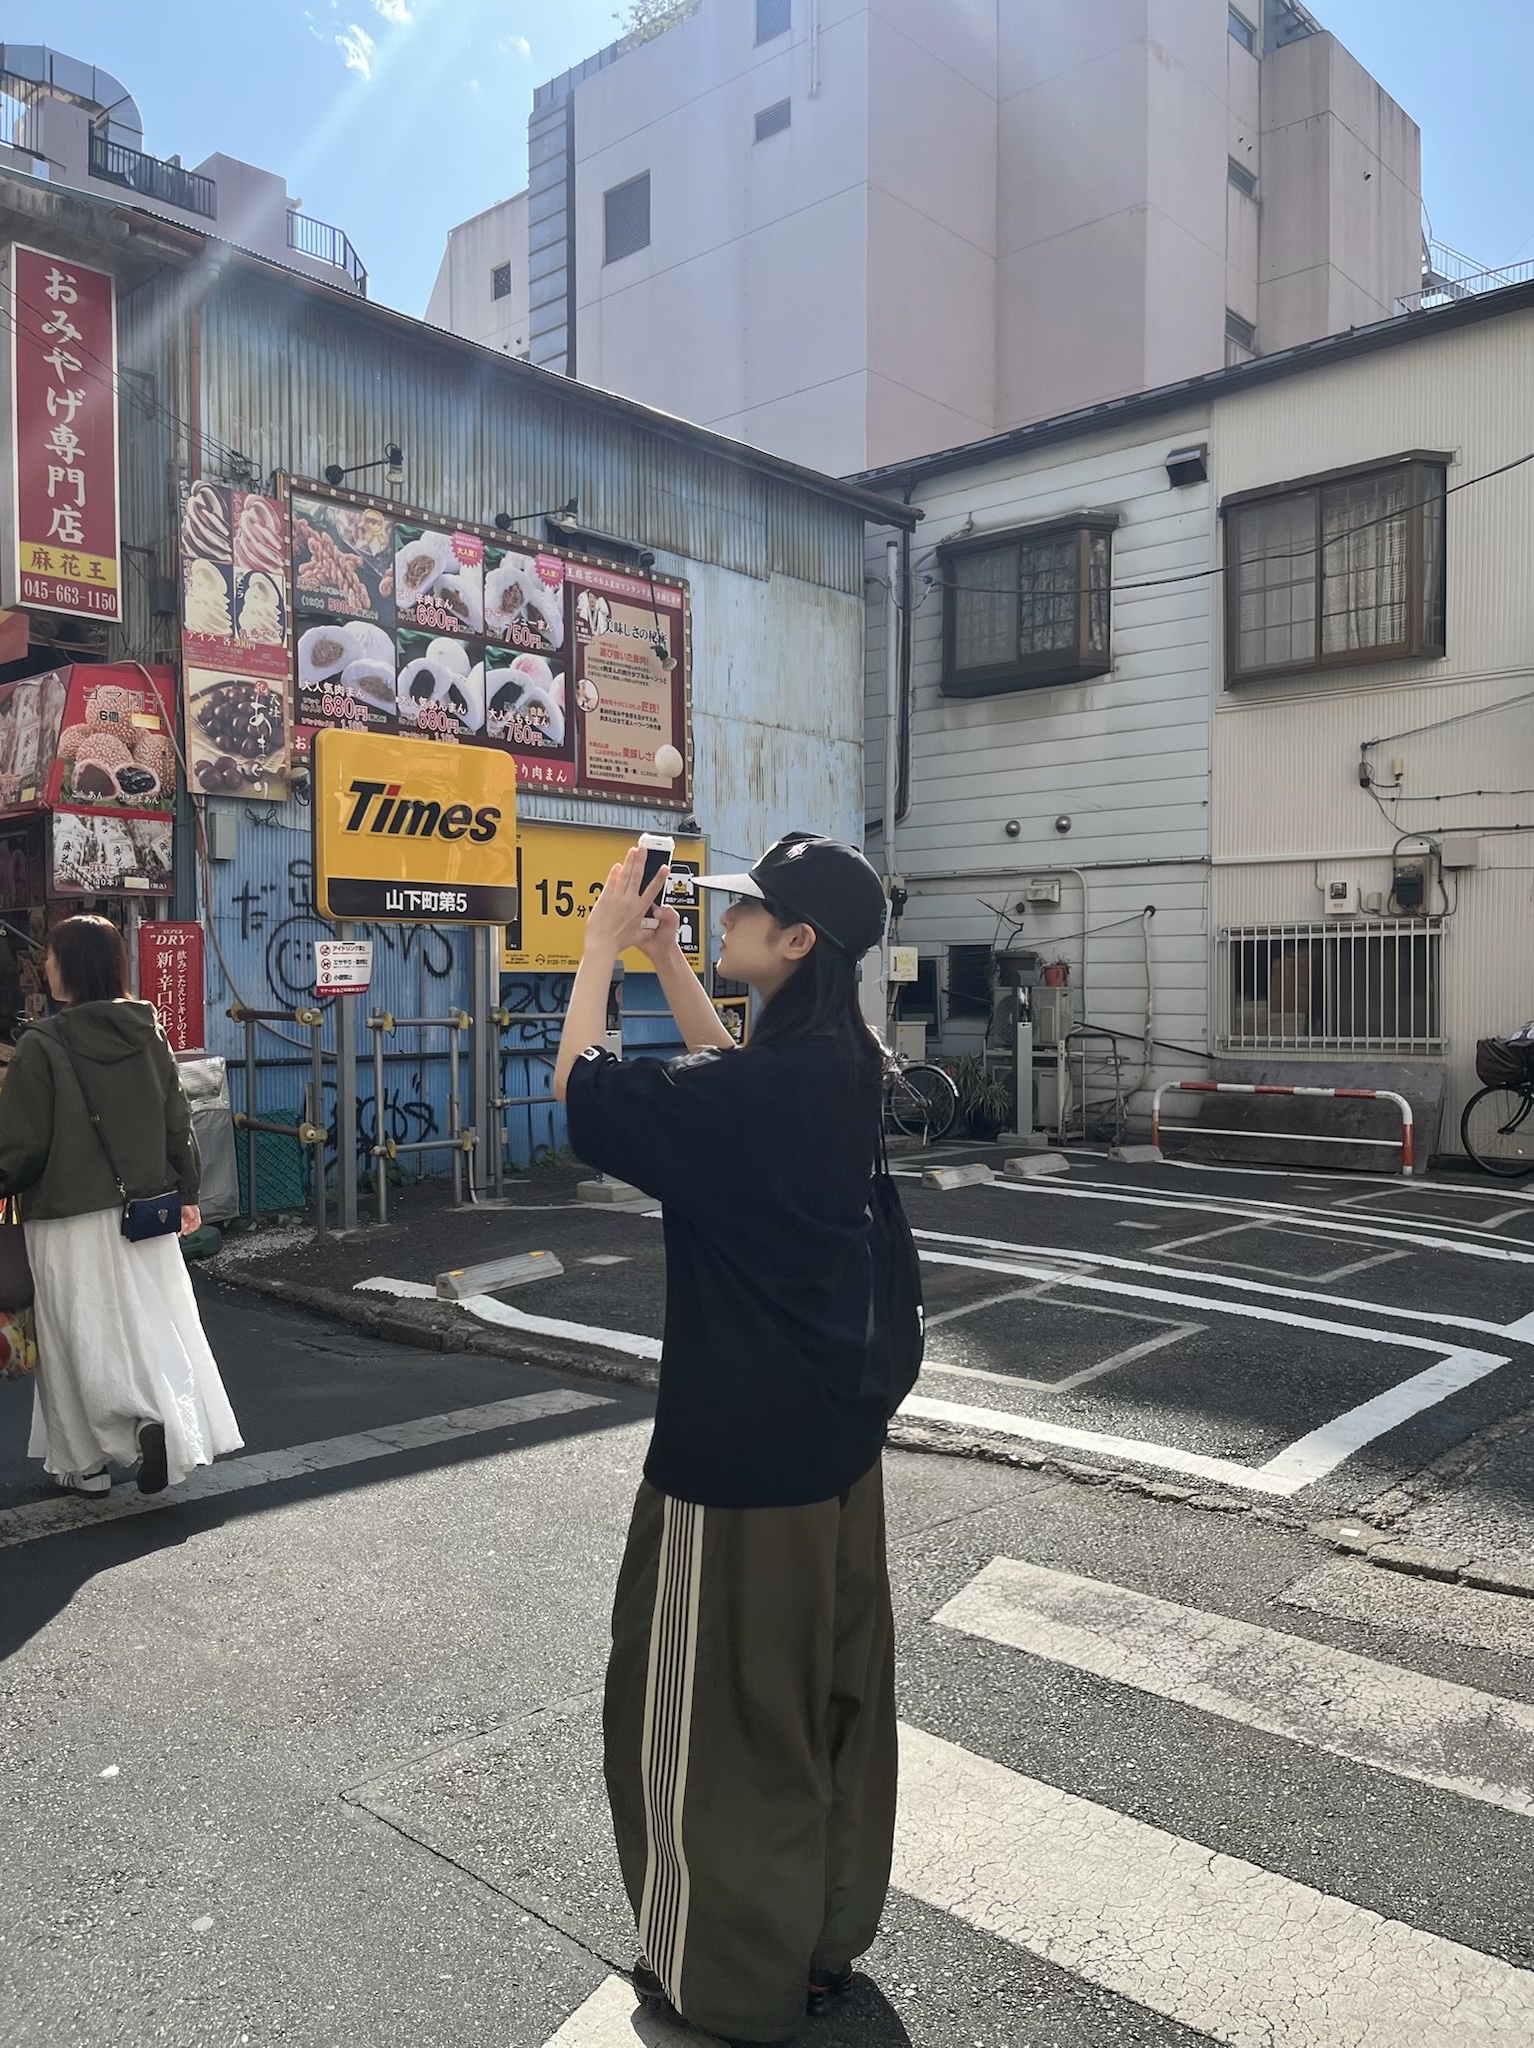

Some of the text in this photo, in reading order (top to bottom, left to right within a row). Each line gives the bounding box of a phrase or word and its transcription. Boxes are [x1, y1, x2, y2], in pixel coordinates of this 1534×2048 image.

[41, 266, 86, 545] おみやげ専門店
[30, 546, 108, 581] 麻花王
[24, 577, 116, 612] 045-663-1150
[417, 604, 459, 633] 680円
[504, 623, 542, 650] 750円
[83, 684, 165, 714] ゴマ団子
[301, 681, 366, 699] 大人気肉まん
[99, 710, 120, 723] 6個
[322, 693, 369, 722] 680円
[417, 708, 460, 735] 680円
[505, 721, 543, 748] 750円
[346, 779, 502, 843] Times
[385, 889, 469, 914] 山下町第5
